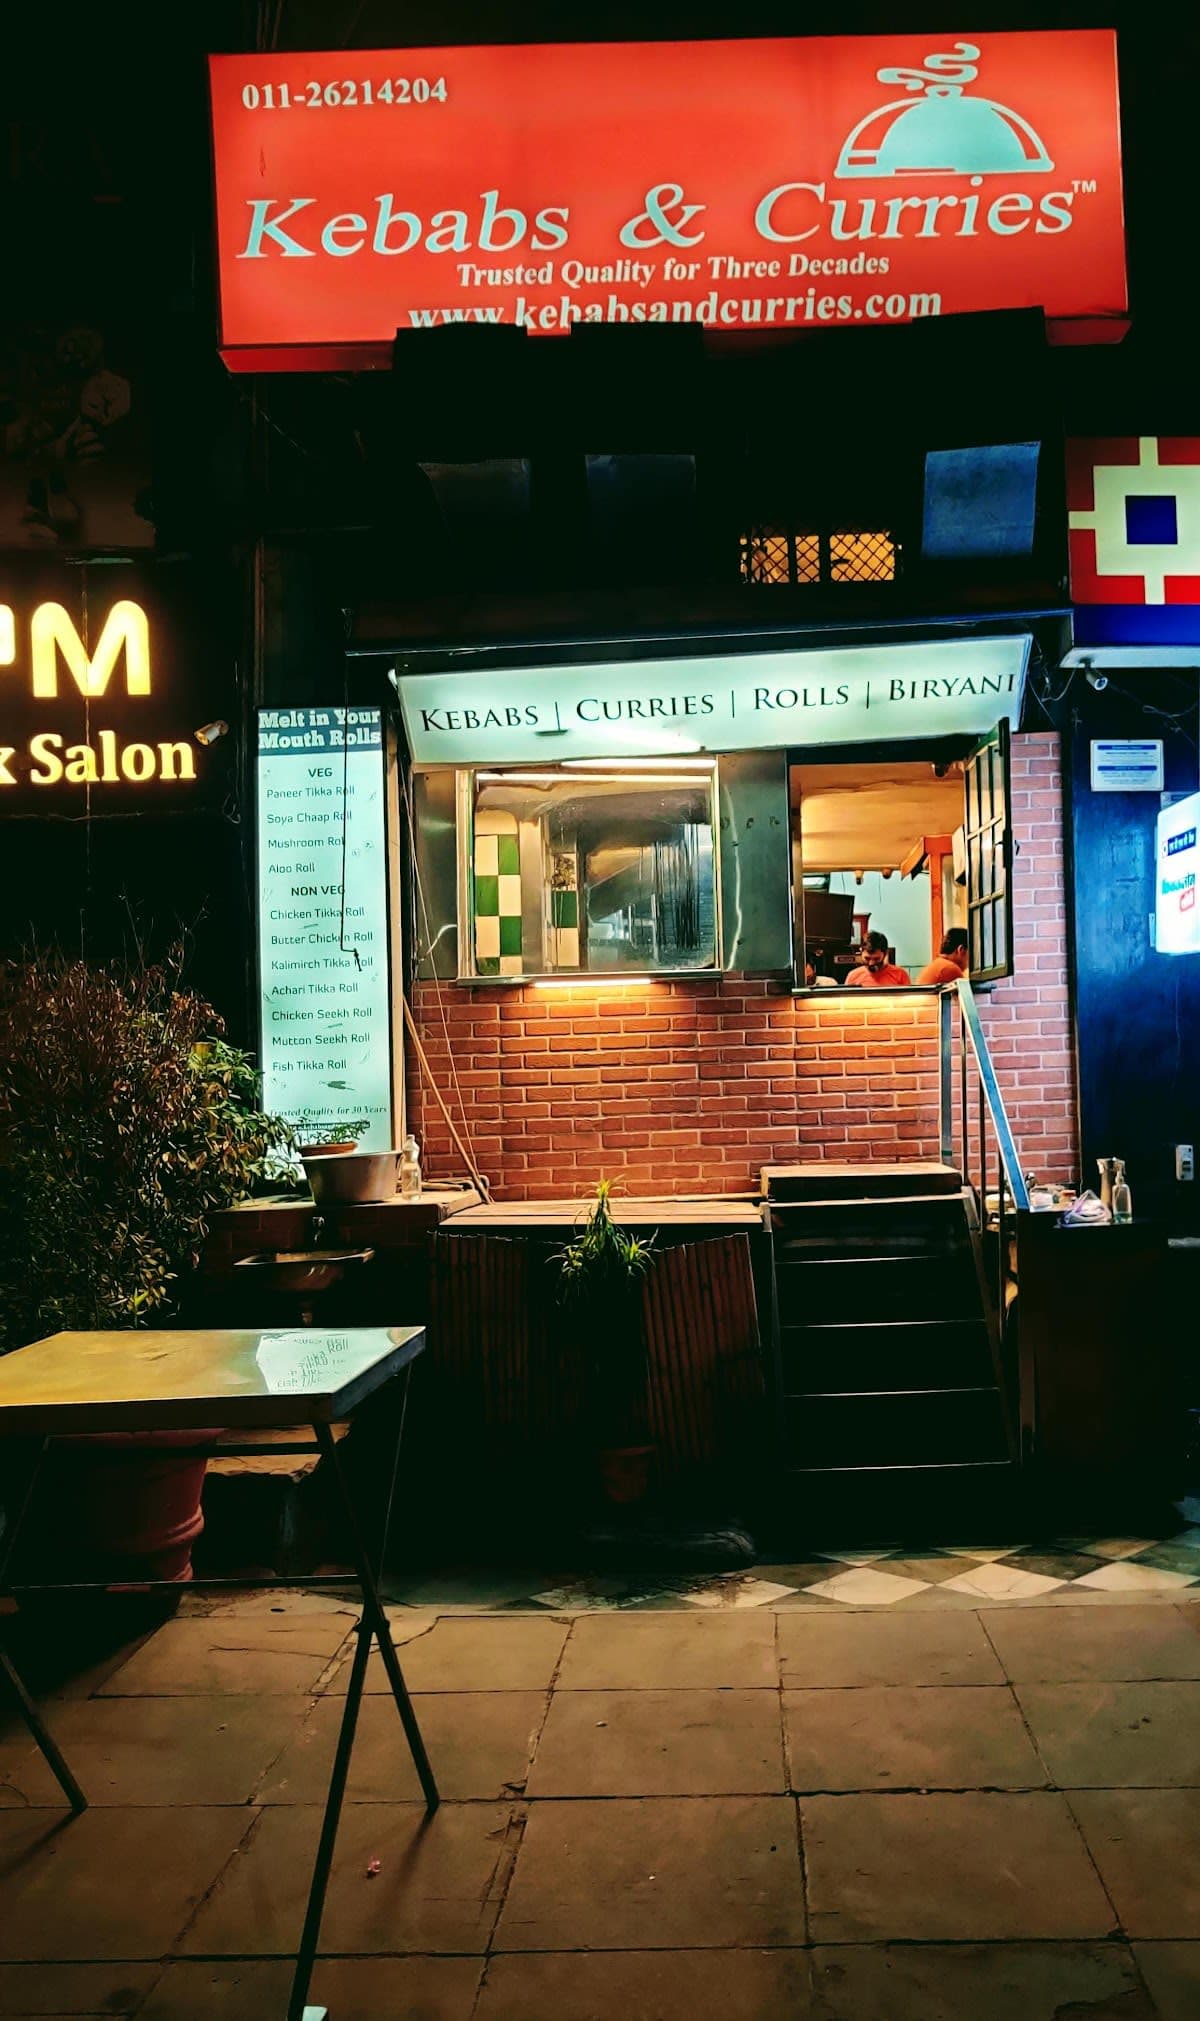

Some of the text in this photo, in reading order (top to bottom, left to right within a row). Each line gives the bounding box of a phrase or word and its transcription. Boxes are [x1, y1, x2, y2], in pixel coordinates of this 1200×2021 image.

[241, 77, 448, 110] 011-26214204
[235, 189, 570, 260] Kebabs
[618, 183, 706, 250] &
[754, 174, 1074, 243] Curries
[457, 251, 890, 288] Trusted Quality for Three Decades
[407, 287, 942, 330] wwwkebabsandcurries.com
[420, 672, 1015, 733] KEBABS CURRIES ROLLS BIRYANI
[258, 708, 381, 729] Melt in Your
[258, 728, 382, 749] Mouth Rolls
[29, 729, 197, 785] Salon
[308, 767, 333, 778] VEG
[266, 785, 355, 799] Paneer Tikka Rll
[266, 813, 294, 825] Soya
[296, 811, 330, 824] Chaap
[268, 836, 345, 849] Mushroom Rol
[268, 862, 316, 874] Aloo Roll
[291, 886, 318, 897] NON
[270, 906, 365, 920] Chicken Tikka Roll
[271, 935, 306, 945] Butter
[353, 931, 373, 942] Roll
[271, 959, 320, 970] Kalimirch
[322, 958, 351, 969] Tikka
[271, 983, 359, 996] Achari Tikka Roll
[271, 1007, 372, 1021] Chicken Seekh Roll
[272, 1032, 371, 1046] Mutton Seekh Roll
[272, 1060, 347, 1072] Fish Tikka Roll
[303, 1107, 333, 1117] Quality
